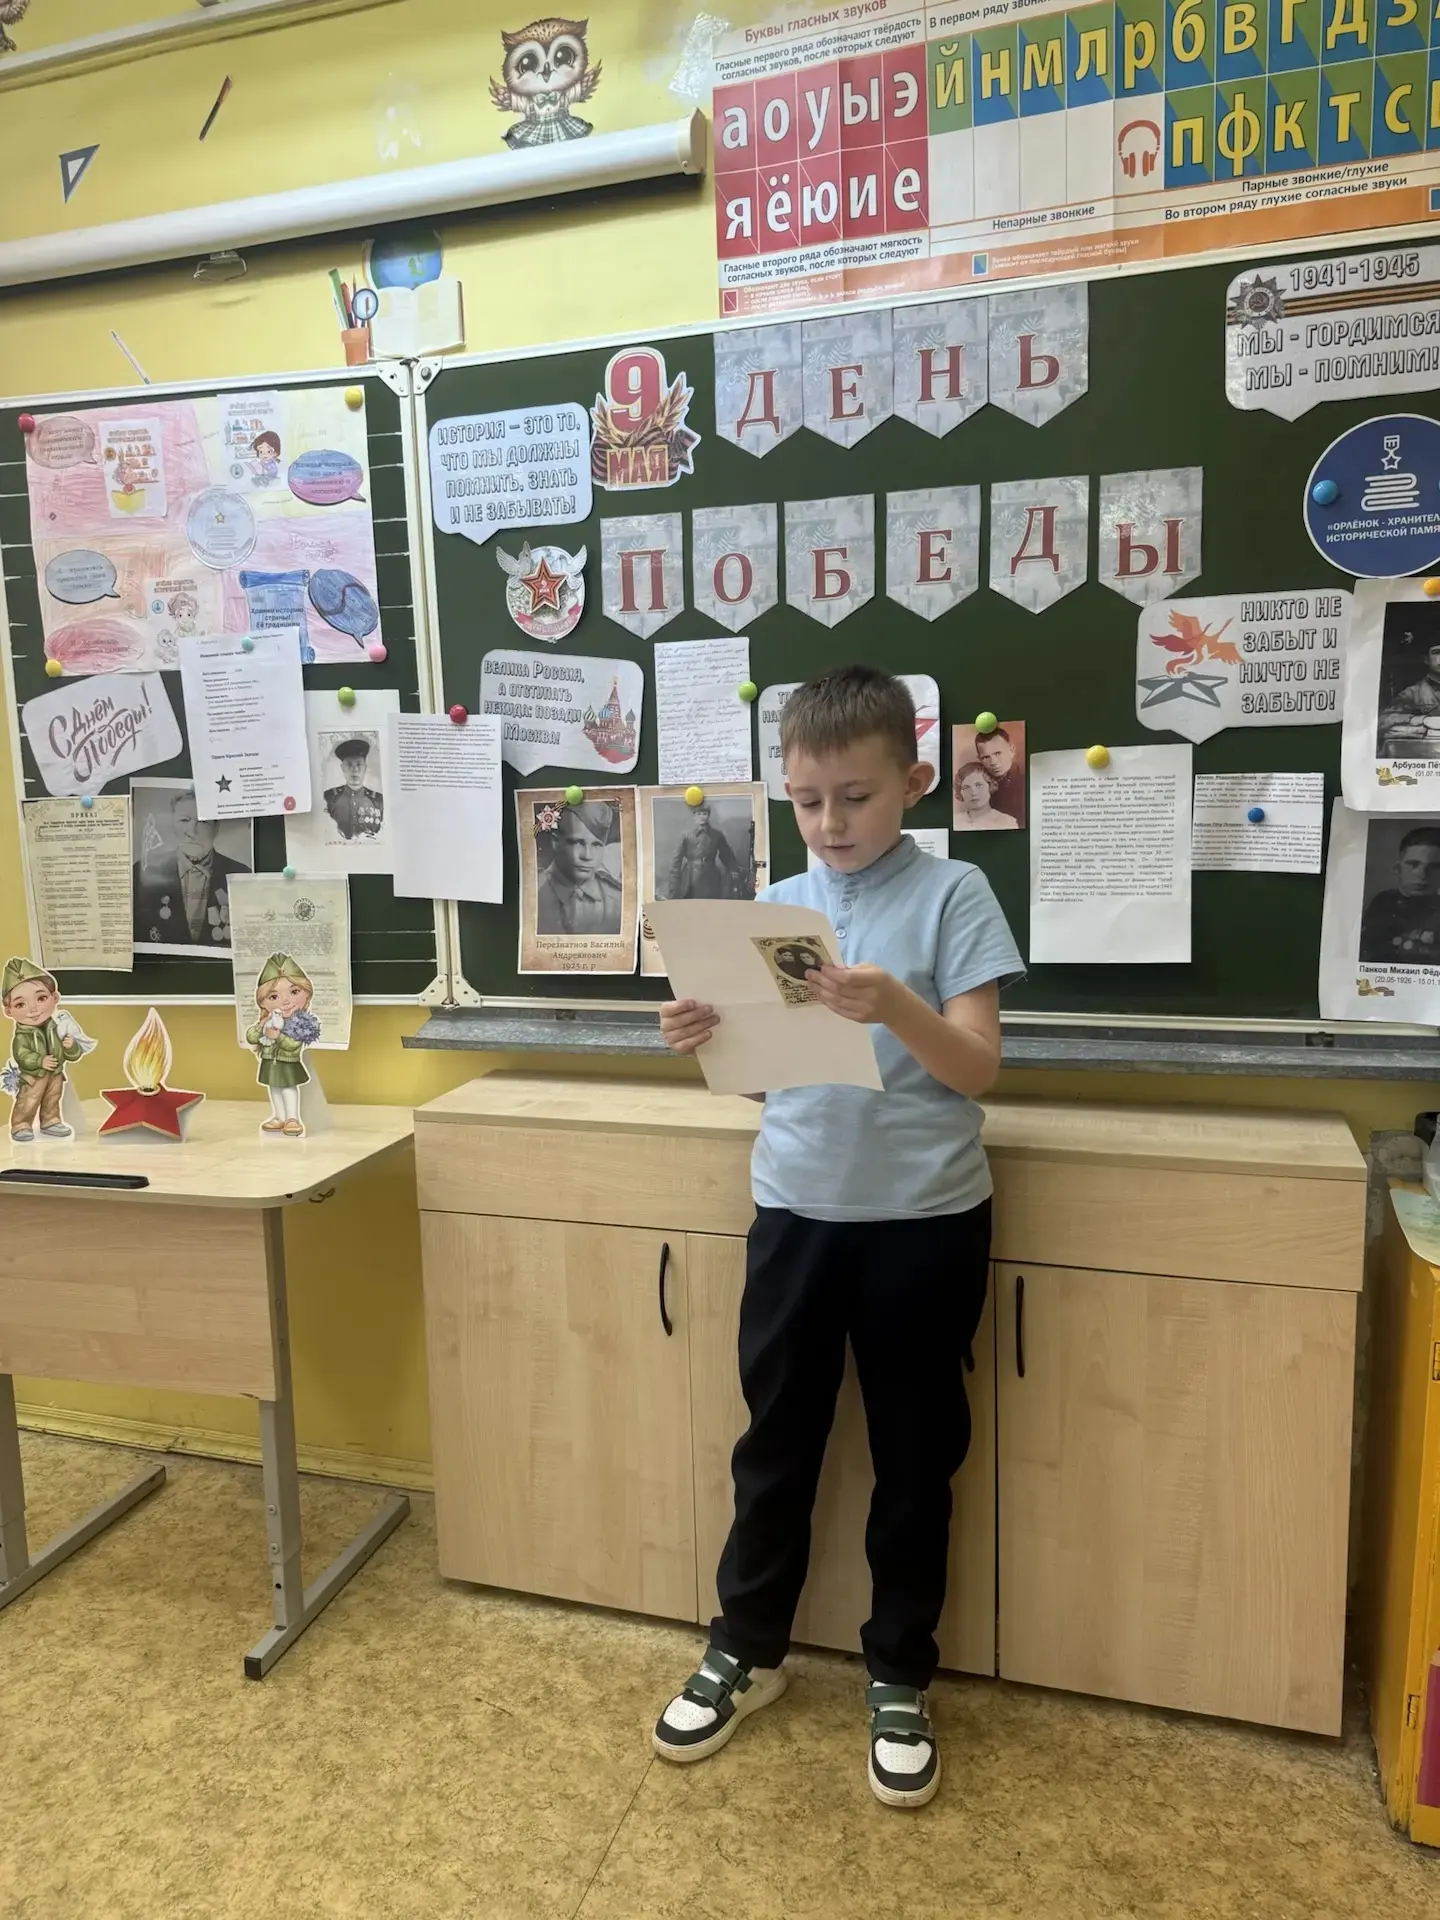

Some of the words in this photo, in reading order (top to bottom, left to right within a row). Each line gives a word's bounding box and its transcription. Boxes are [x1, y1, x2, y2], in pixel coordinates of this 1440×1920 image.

[745, 24, 784, 44] Буквы
[788, 10, 839, 32] гласных
[843, 0, 887, 18] звуков
[930, 17, 937, 29] В
[940, 9, 980, 26] первом
[983, 1, 1009, 18] ряду
[715, 57, 752, 72] Гласные
[754, 48, 790, 63] первого
[791, 42, 814, 56] ряда
[816, 30, 871, 48] обозначают
[874, 18, 922, 35] твёрдость
[721, 65, 767, 81] согласных
[769, 57, 802, 71] звуков,
[804, 49, 830, 63] после
[833, 40, 873, 55] которых
[875, 30, 916, 47] следуют
[934, 41, 965, 110] й
[980, 49, 1011, 100] н
[1022, 38, 1064, 91] м
[1075, 27, 1108, 81] л
[1124, 19, 1157, 89] р
[721, 105, 748, 151] а
[805, 85, 831, 151] у
[842, 77, 881, 126] ы
[892, 71, 919, 119] э
[1171, 116, 1204, 169] п
[1217, 92, 1261, 177] ф
[1242, 176, 1288, 193] Парные
[1291, 162, 1389, 185] звонкие/глухие
[725, 197, 752, 241] я
[766, 173, 792, 233] ё
[802, 180, 839, 228] ю
[849, 172, 878, 220] и
[893, 167, 921, 212] е
[1165, 209, 1180, 220] Во
[1183, 203, 1226, 219] втором
[1229, 198, 1258, 214] ряду
[1261, 191, 1302, 207] глухие
[1305, 182, 1369, 199] согласные
[1372, 175, 1407, 193] звуки
[992, 214, 1047, 230] Непарные
[1050, 206, 1095, 221] звонкие
[724, 261, 760, 273] Гласные
[762, 256, 797, 268] второго
[799, 251, 821, 262] ряда
[823, 242, 878, 257] обозначают
[880, 237, 923, 250] мягкость
[727, 270, 772, 283] согласных
[775, 265, 807, 278] звуков,
[809, 259, 835, 270] после
[837, 253, 877, 267] которых
[879, 247, 920, 261] следуют
[1290, 252, 1420, 292] 1941-1945
[1237, 329, 1283, 357] МЫ
[1306, 309, 1440, 348] ГОРДИМСЯ
[736, 332, 1062, 438] ДЕНЬ
[1245, 363, 1292, 391] МЫ
[1315, 346, 1440, 383] ПОМНИМ!
[610, 352, 664, 433] 9
[437, 420, 506, 445] ИСТОРИЯ
[524, 414, 554, 436] ЭТО
[556, 412, 581, 430] ТО,
[440, 452, 469, 471] ЧТО
[472, 448, 502, 469] МЫ
[505, 440, 580, 467] ДОЛЖНЫ
[606, 444, 669, 485] МАЯ
[446, 473, 524, 499] ПОМНИТЬ,
[528, 468, 578, 490] ЗНАТЬ
[450, 506, 461, 524] И
[464, 502, 483, 522] НЕ
[487, 495, 576, 520] ЗАБЫВАТЬ!
[1326, 527, 1407, 543] ИСТОРИЧЕСКОЙ
[616, 503, 1185, 614] ПОБЕДЫ
[1241, 597, 1309, 622] НИКТО
[1315, 596, 1342, 618] НЕ
[1243, 629, 1317, 653] ЗАБЫТ
[1323, 628, 1337, 649] И
[1239, 660, 1307, 683] НИЧТО
[1314, 658, 1340, 681] НЕ
[1241, 690, 1335, 713] ЗАБЫТО!
[48, 714, 72, 759] С
[71, 696, 115, 745] Днём
[72, 680, 153, 782] Победы!
[1392, 761, 1426, 771] Арбузов
[590, 941, 625, 949] Василий
[562, 963, 580, 971] 1925
[1360, 965, 1388, 974] Панков
[1390, 966, 1420, 975] Михаил
